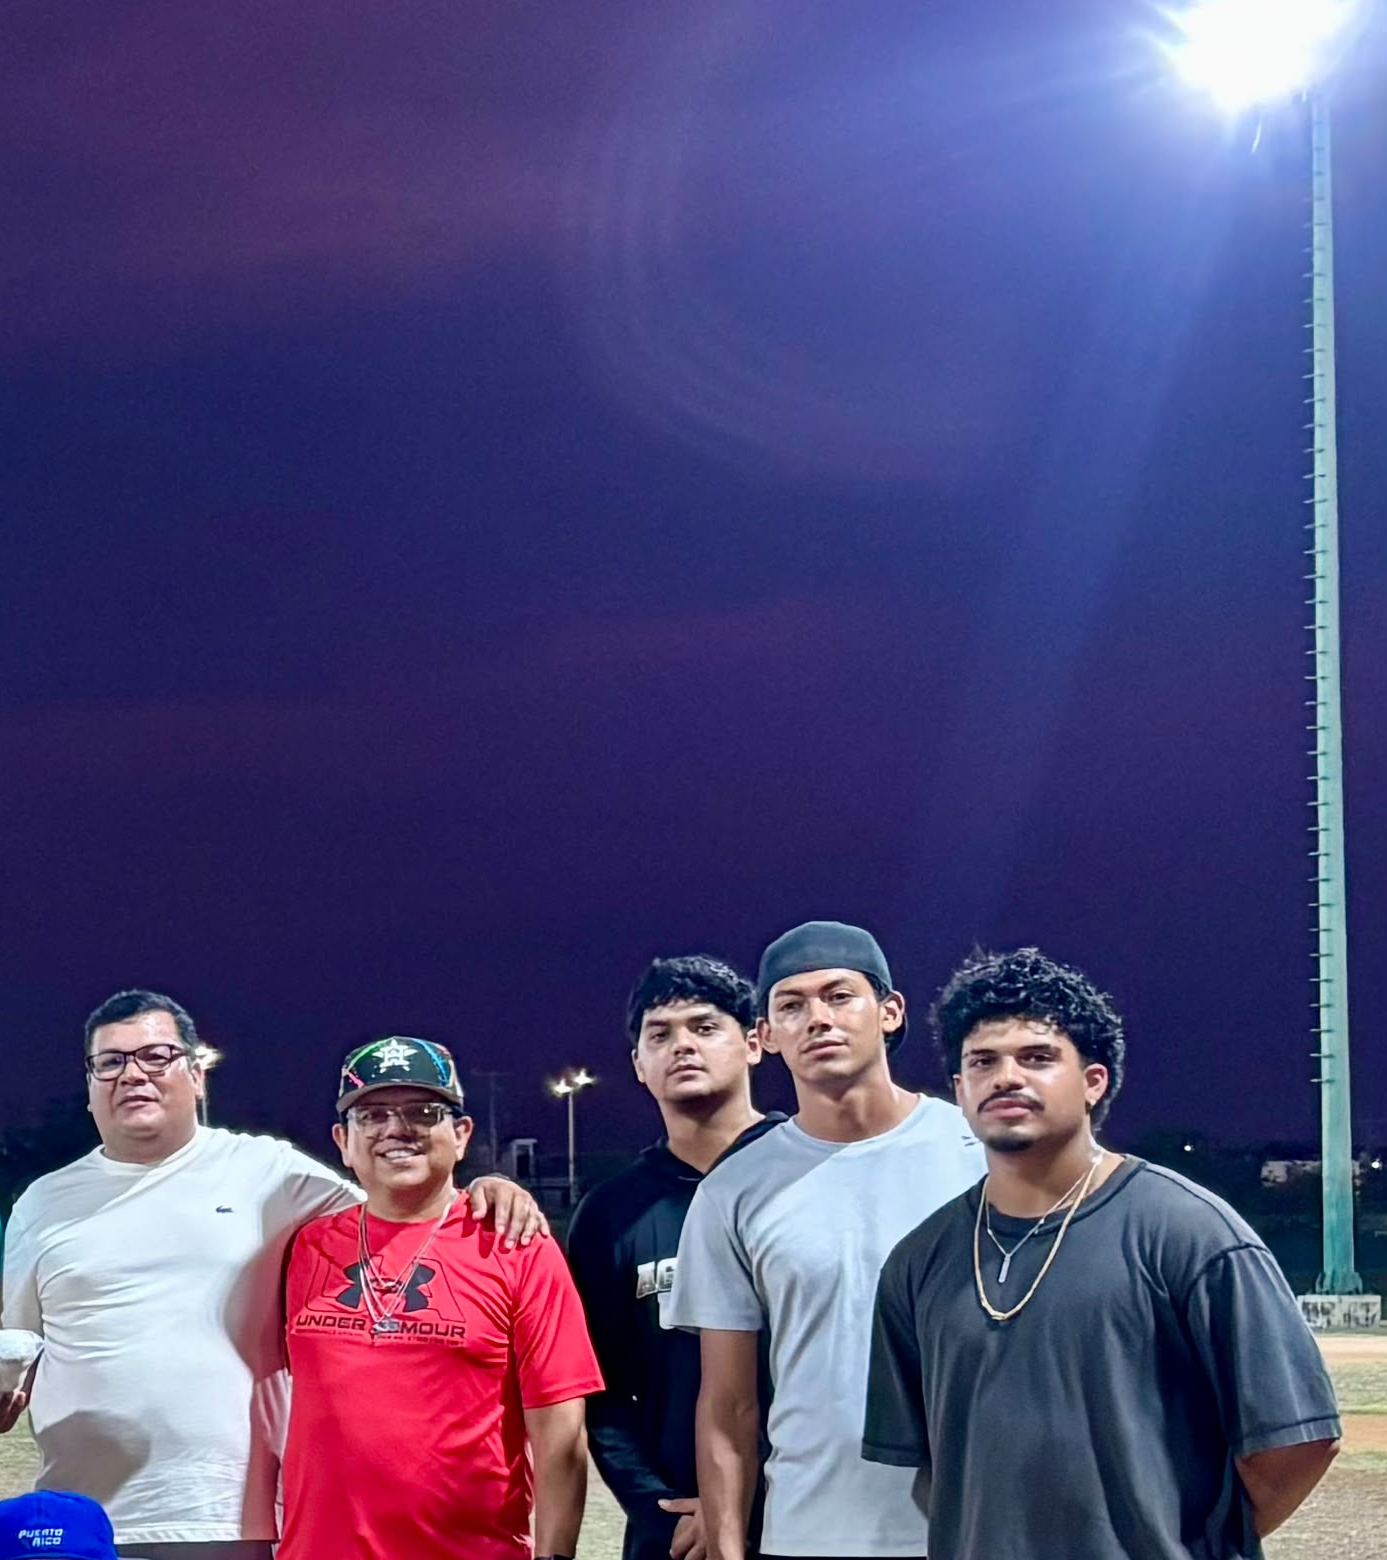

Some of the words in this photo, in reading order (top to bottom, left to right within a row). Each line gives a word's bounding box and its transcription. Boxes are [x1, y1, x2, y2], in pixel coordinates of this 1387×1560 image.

[296, 1314, 366, 1331] UNDER
[372, 1320, 466, 1339] MOUR
[18, 1528, 64, 1539] PUERTO
[32, 1537, 62, 1547] RICO
